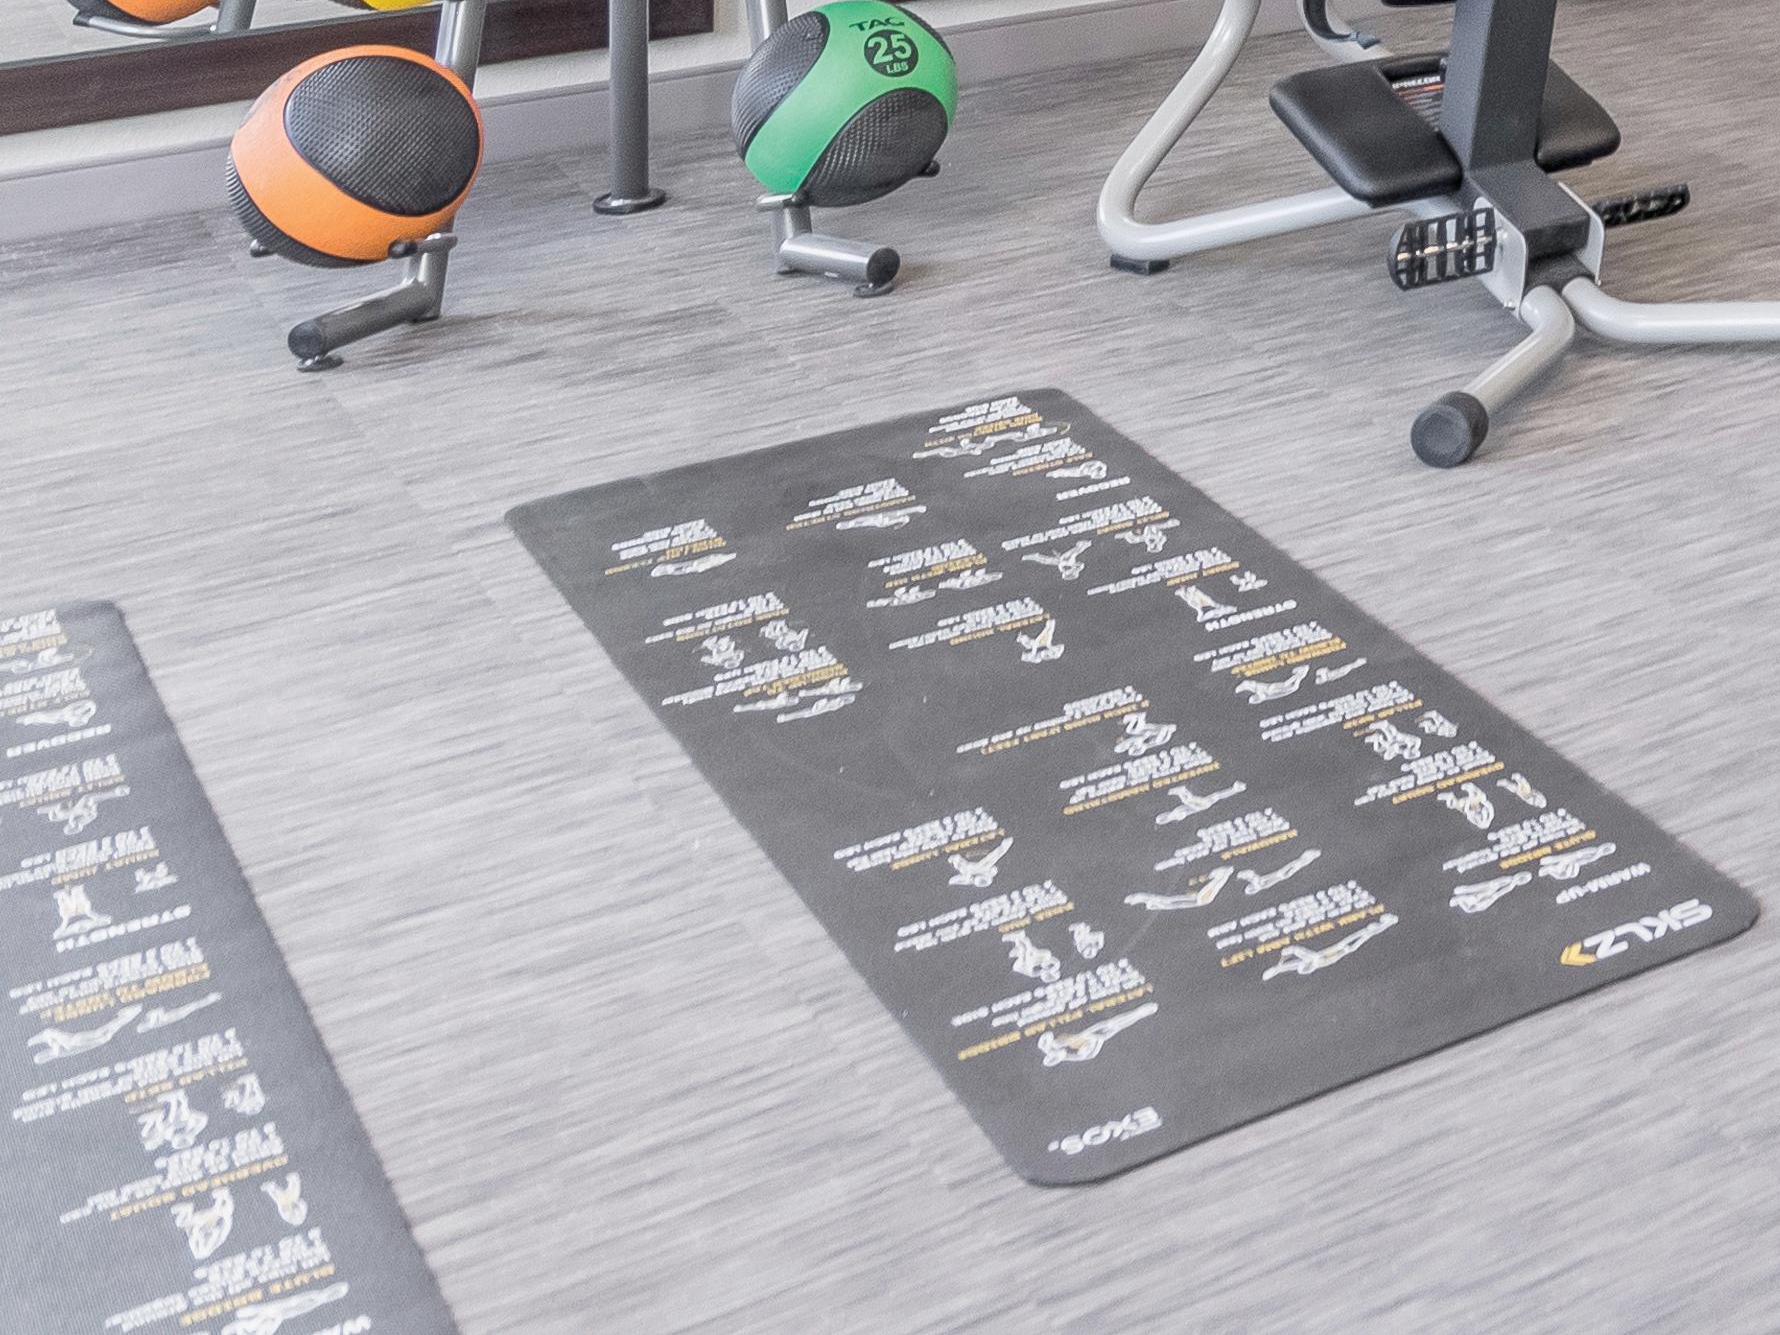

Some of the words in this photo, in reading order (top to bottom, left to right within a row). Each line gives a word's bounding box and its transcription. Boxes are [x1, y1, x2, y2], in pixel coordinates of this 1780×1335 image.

[849, 17, 905, 31] TAG
[868, 34, 912, 65] 25
[886, 61, 909, 74] LBS
[1552, 859, 1651, 907] WARM-UP
[1583, 898, 1713, 959] SKLZ
[1060, 1106, 1160, 1155] EXOS
